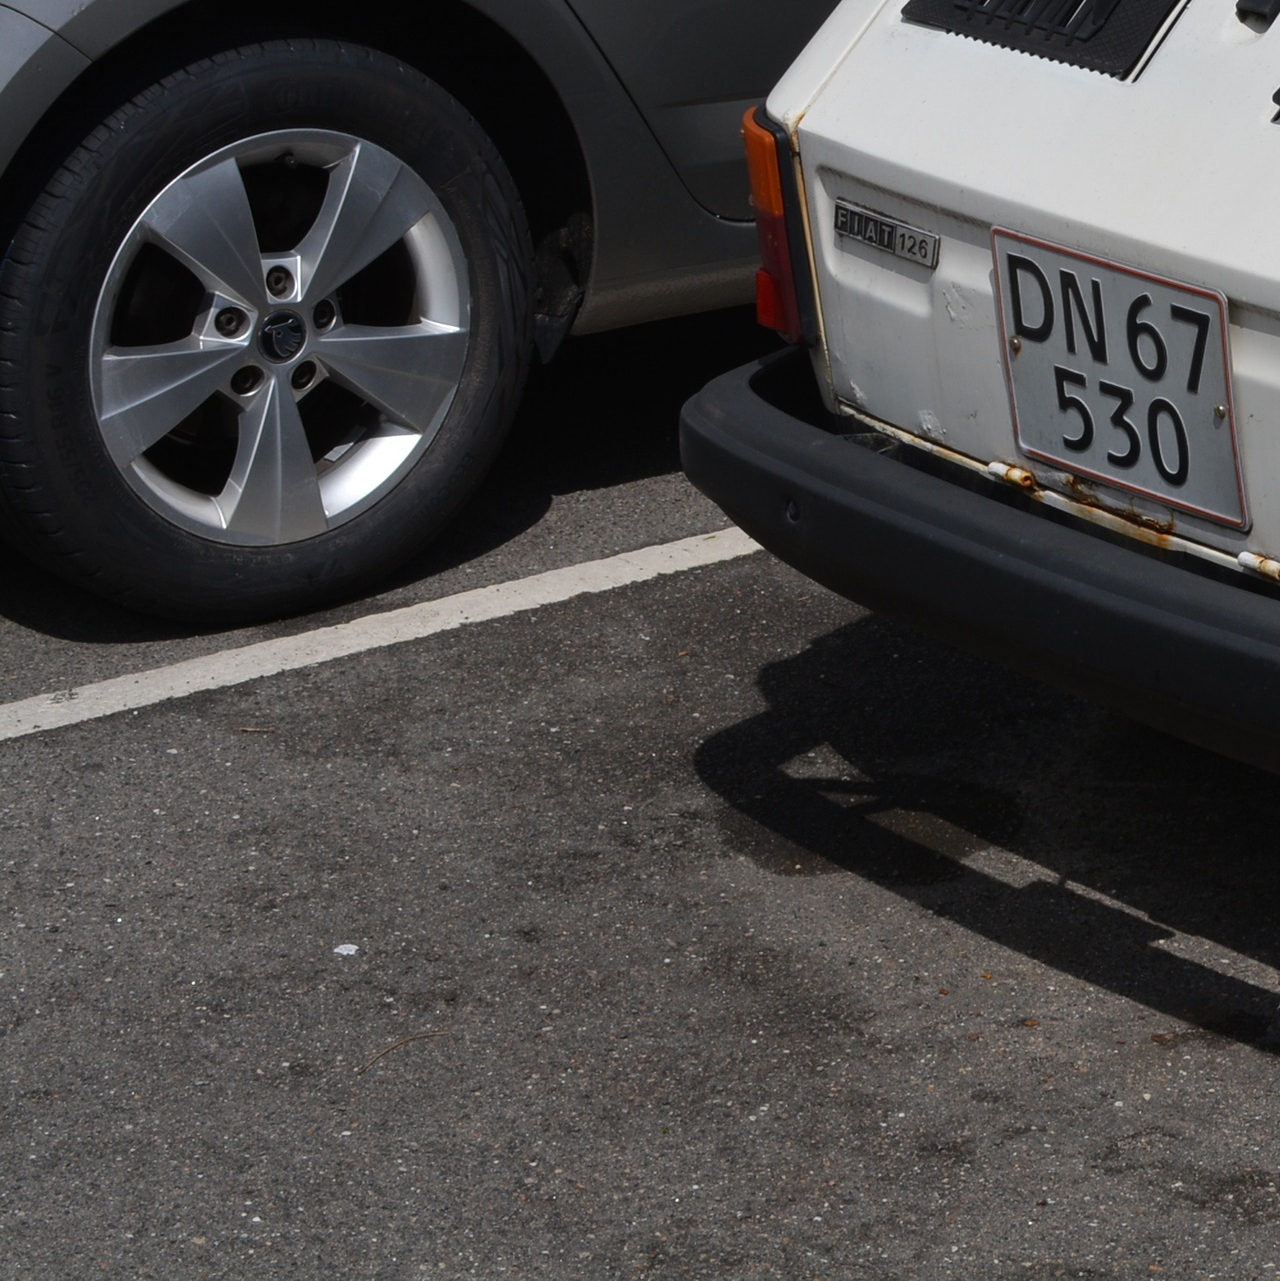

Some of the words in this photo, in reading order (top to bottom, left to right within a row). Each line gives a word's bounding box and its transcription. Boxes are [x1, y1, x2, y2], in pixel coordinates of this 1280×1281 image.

[837, 207, 892, 247] FIAT
[899, 232, 929, 259] 126
[1007, 251, 1109, 365] DN
[1126, 292, 1211, 394] 67
[1054, 363, 1191, 487] 530
